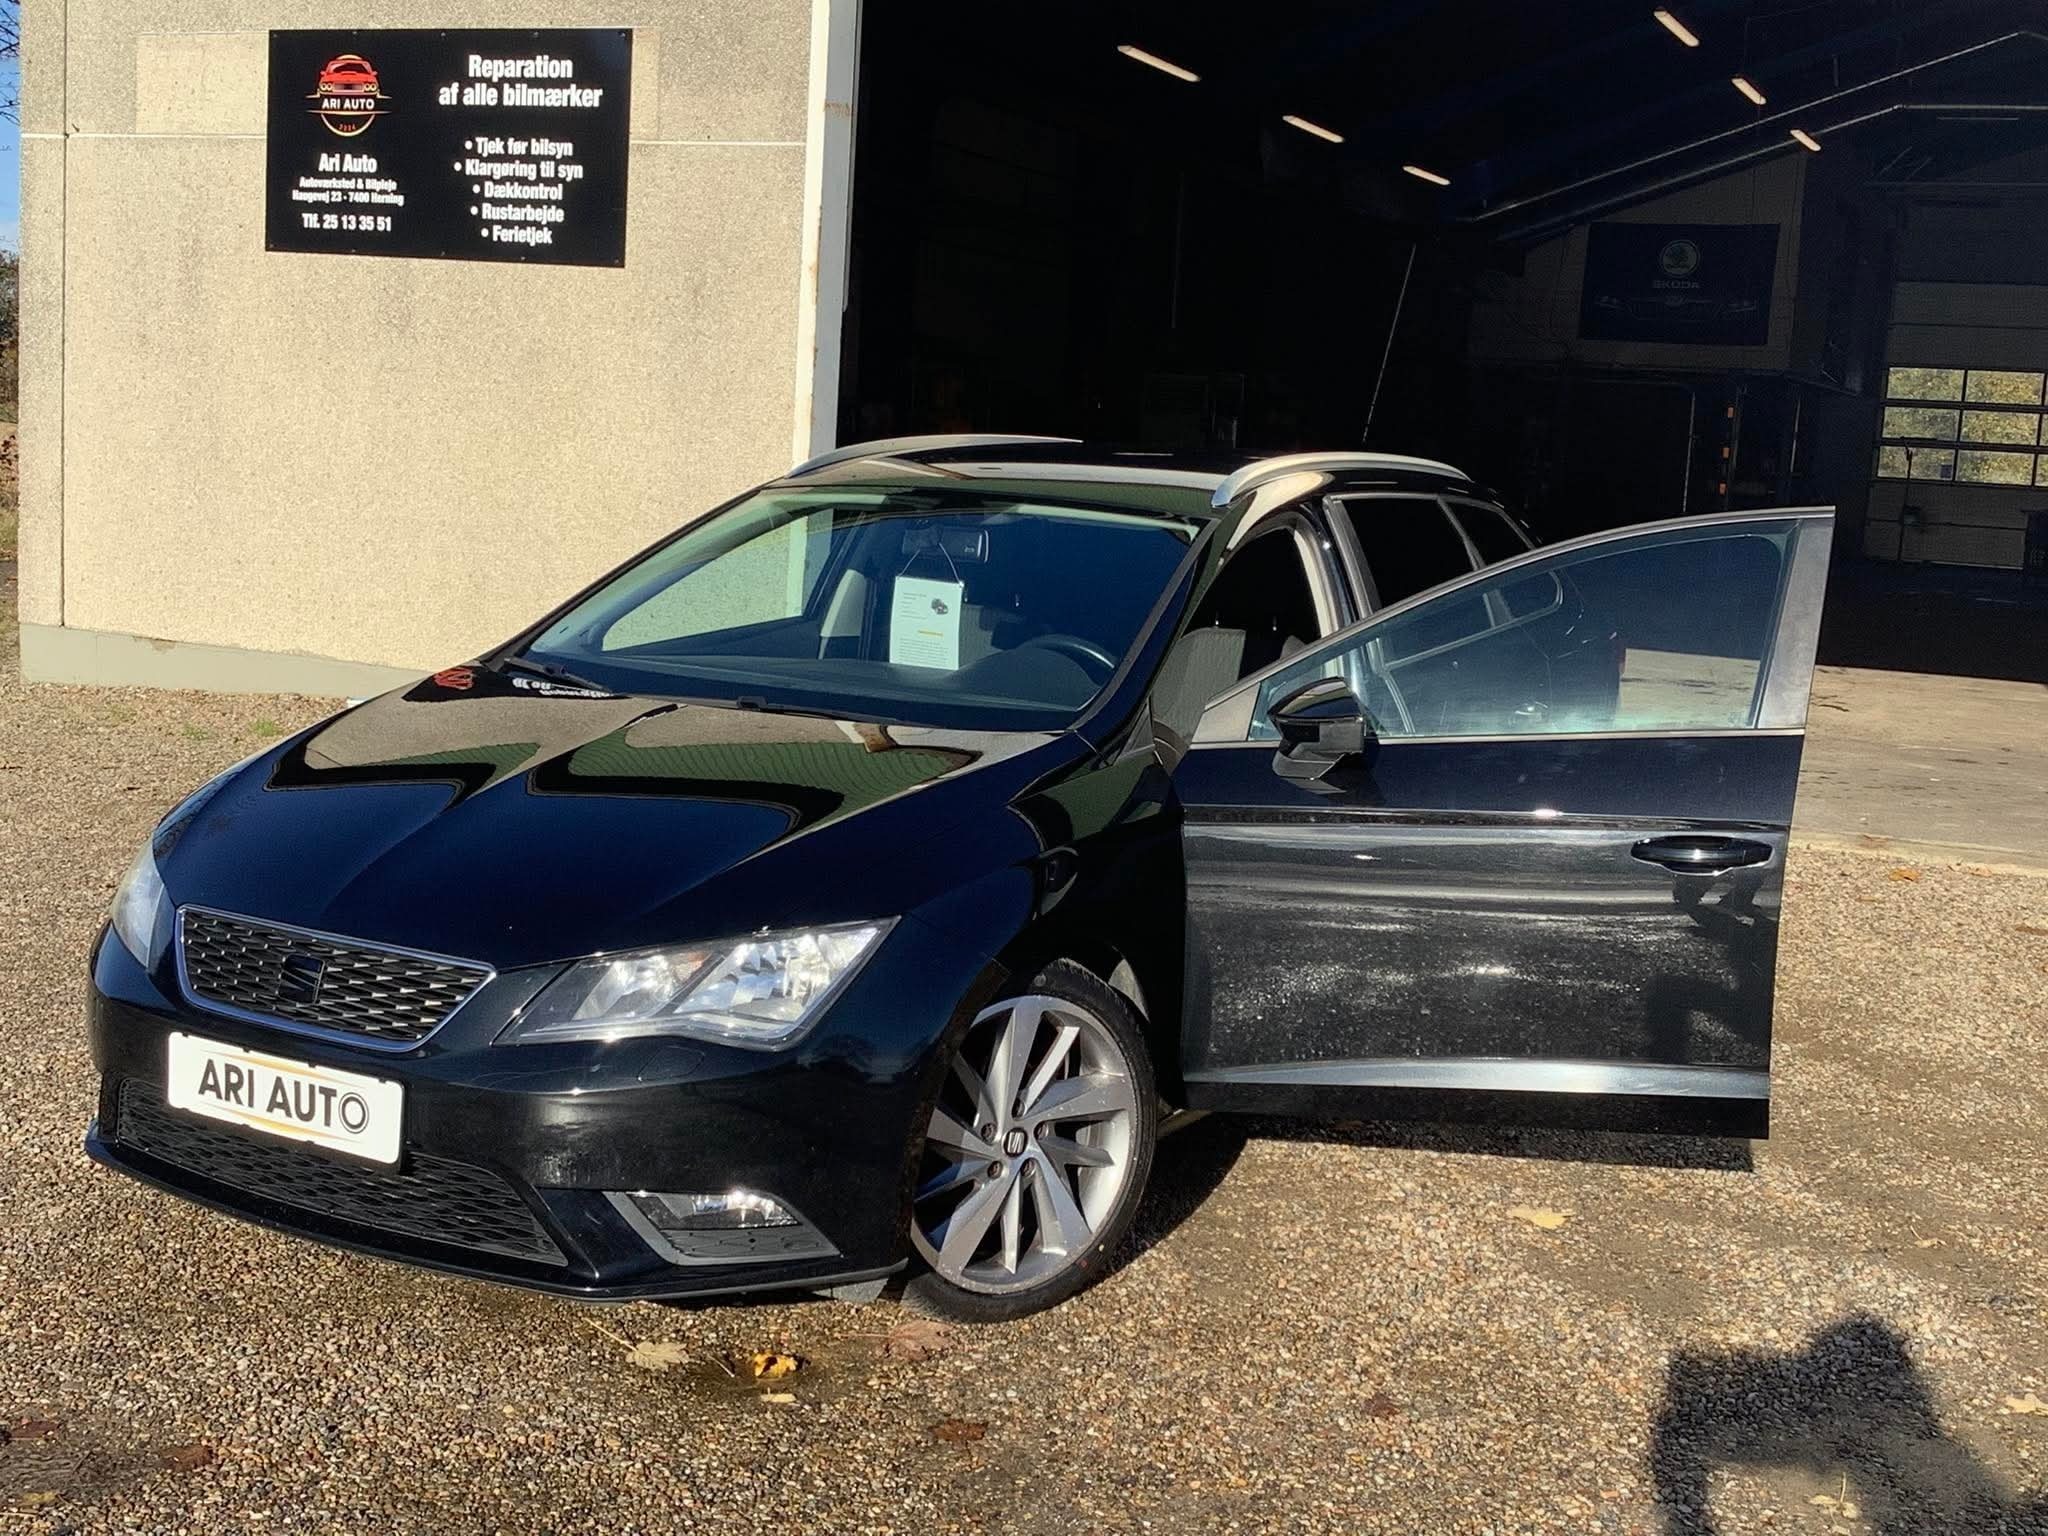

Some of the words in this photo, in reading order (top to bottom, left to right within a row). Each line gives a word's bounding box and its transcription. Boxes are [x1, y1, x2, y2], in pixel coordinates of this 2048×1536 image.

[468, 54, 573, 82] Reparation
[321, 98, 341, 110] ARI
[343, 98, 375, 110] AUTO
[438, 82, 460, 106] af
[462, 83, 498, 106] alle
[503, 83, 603, 107] bilmærker
[475, 137, 505, 158] Tjek
[507, 137, 529, 156] før
[530, 138, 574, 159] bilsyn
[318, 153, 340, 172] Ari
[342, 153, 378, 173] Auto
[465, 159, 537, 181] Klargøring
[540, 161, 556, 178] til
[557, 164, 584, 182] syn
[356, 178, 364, 190] &
[484, 181, 564, 201] Dækkontrol
[331, 191, 342, 203] 23
[348, 192, 370, 203] 7400
[322, 213, 339, 230] 25
[341, 214, 357, 230] 13
[358, 215, 375, 231] 35
[376, 215, 392, 232] 51
[481, 202, 565, 225] Rustarbejde
[492, 225, 553, 247] Ferietjek
[198, 1058, 255, 1109] ARI
[266, 1076, 370, 1134] AUTO
